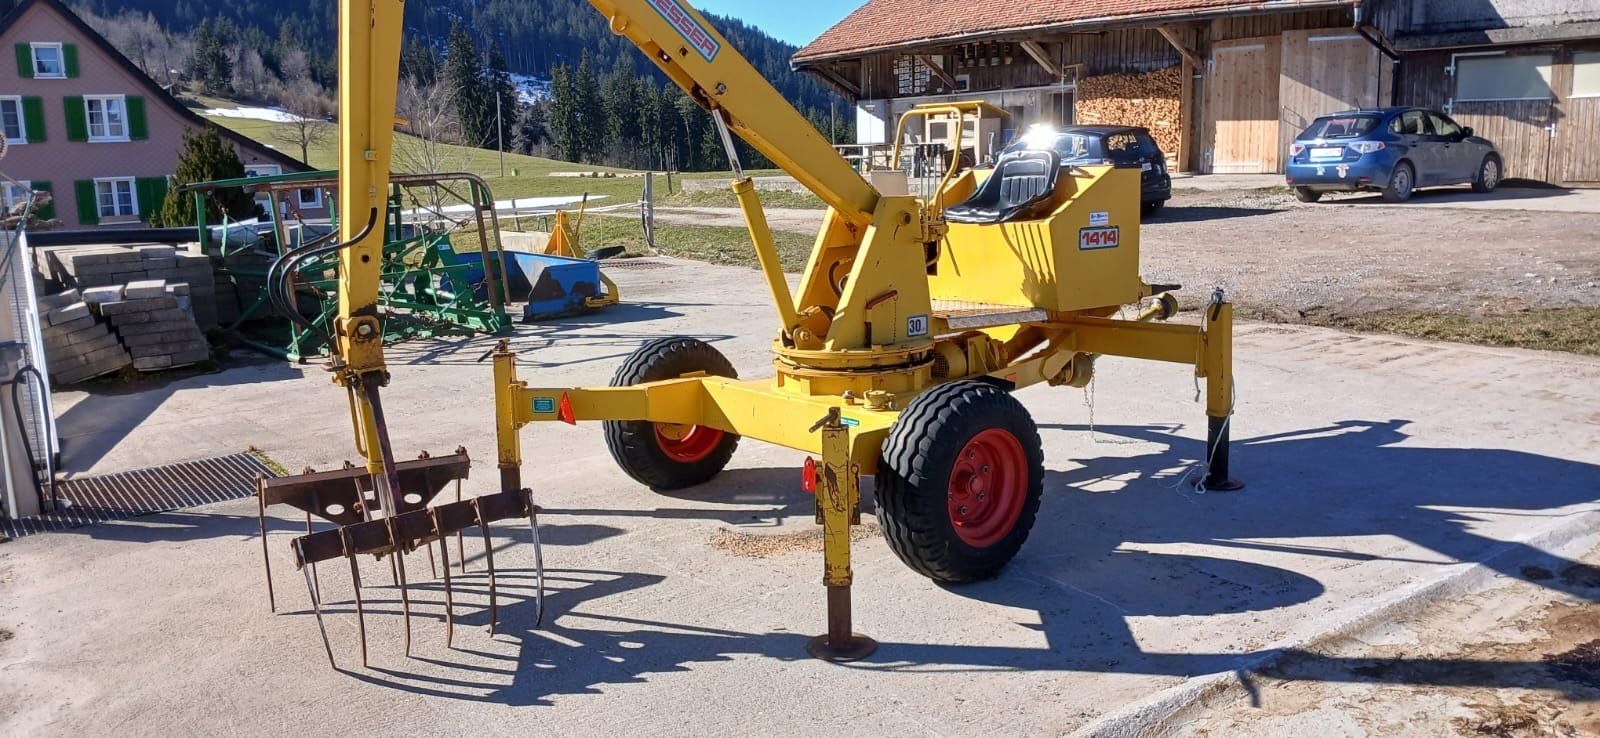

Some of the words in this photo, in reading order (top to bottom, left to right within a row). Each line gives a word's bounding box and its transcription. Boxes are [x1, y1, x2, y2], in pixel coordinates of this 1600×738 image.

[653, 0, 717, 57] ESSER
[1082, 230, 1116, 246] 1414
[909, 319, 921, 333] 30
